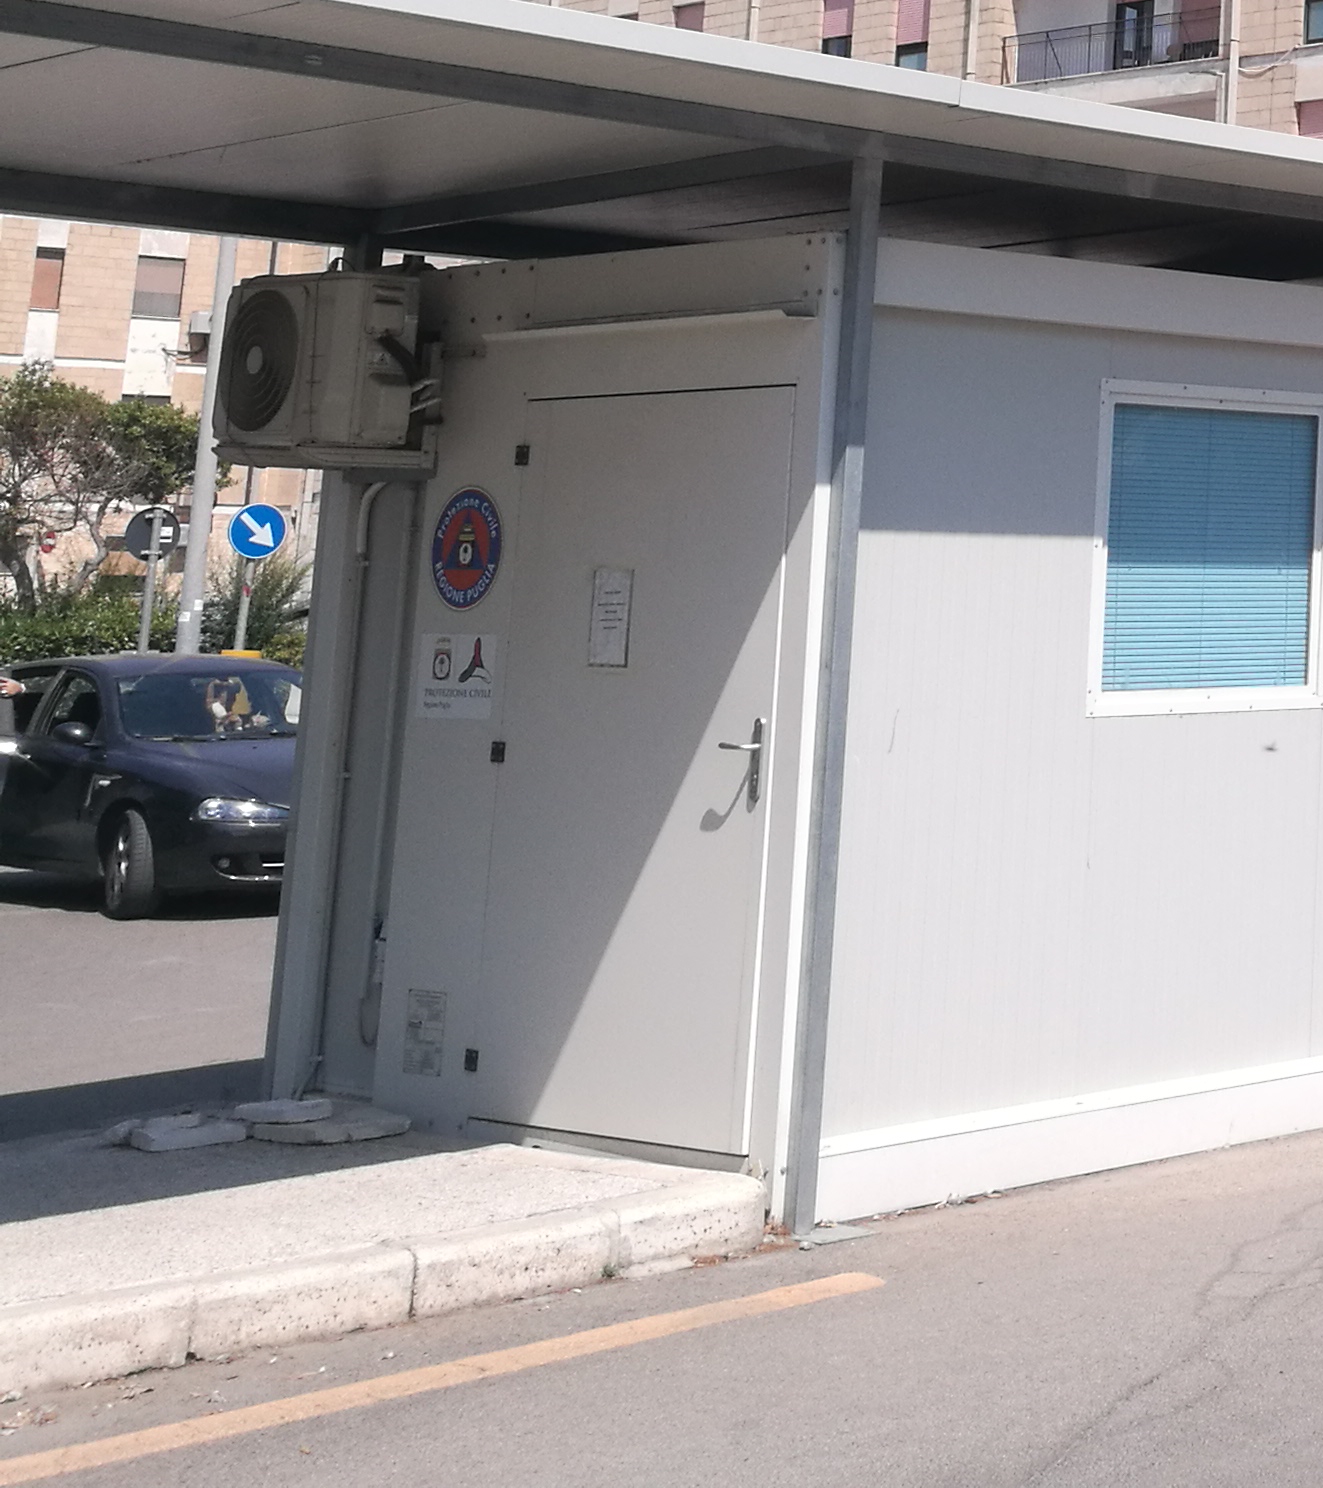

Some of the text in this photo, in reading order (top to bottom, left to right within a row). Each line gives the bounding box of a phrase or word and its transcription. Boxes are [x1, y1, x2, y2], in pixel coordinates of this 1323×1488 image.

[437, 498, 498, 539] Protezione Civile
[435, 562, 495, 603] REGIONE PUGLIA
